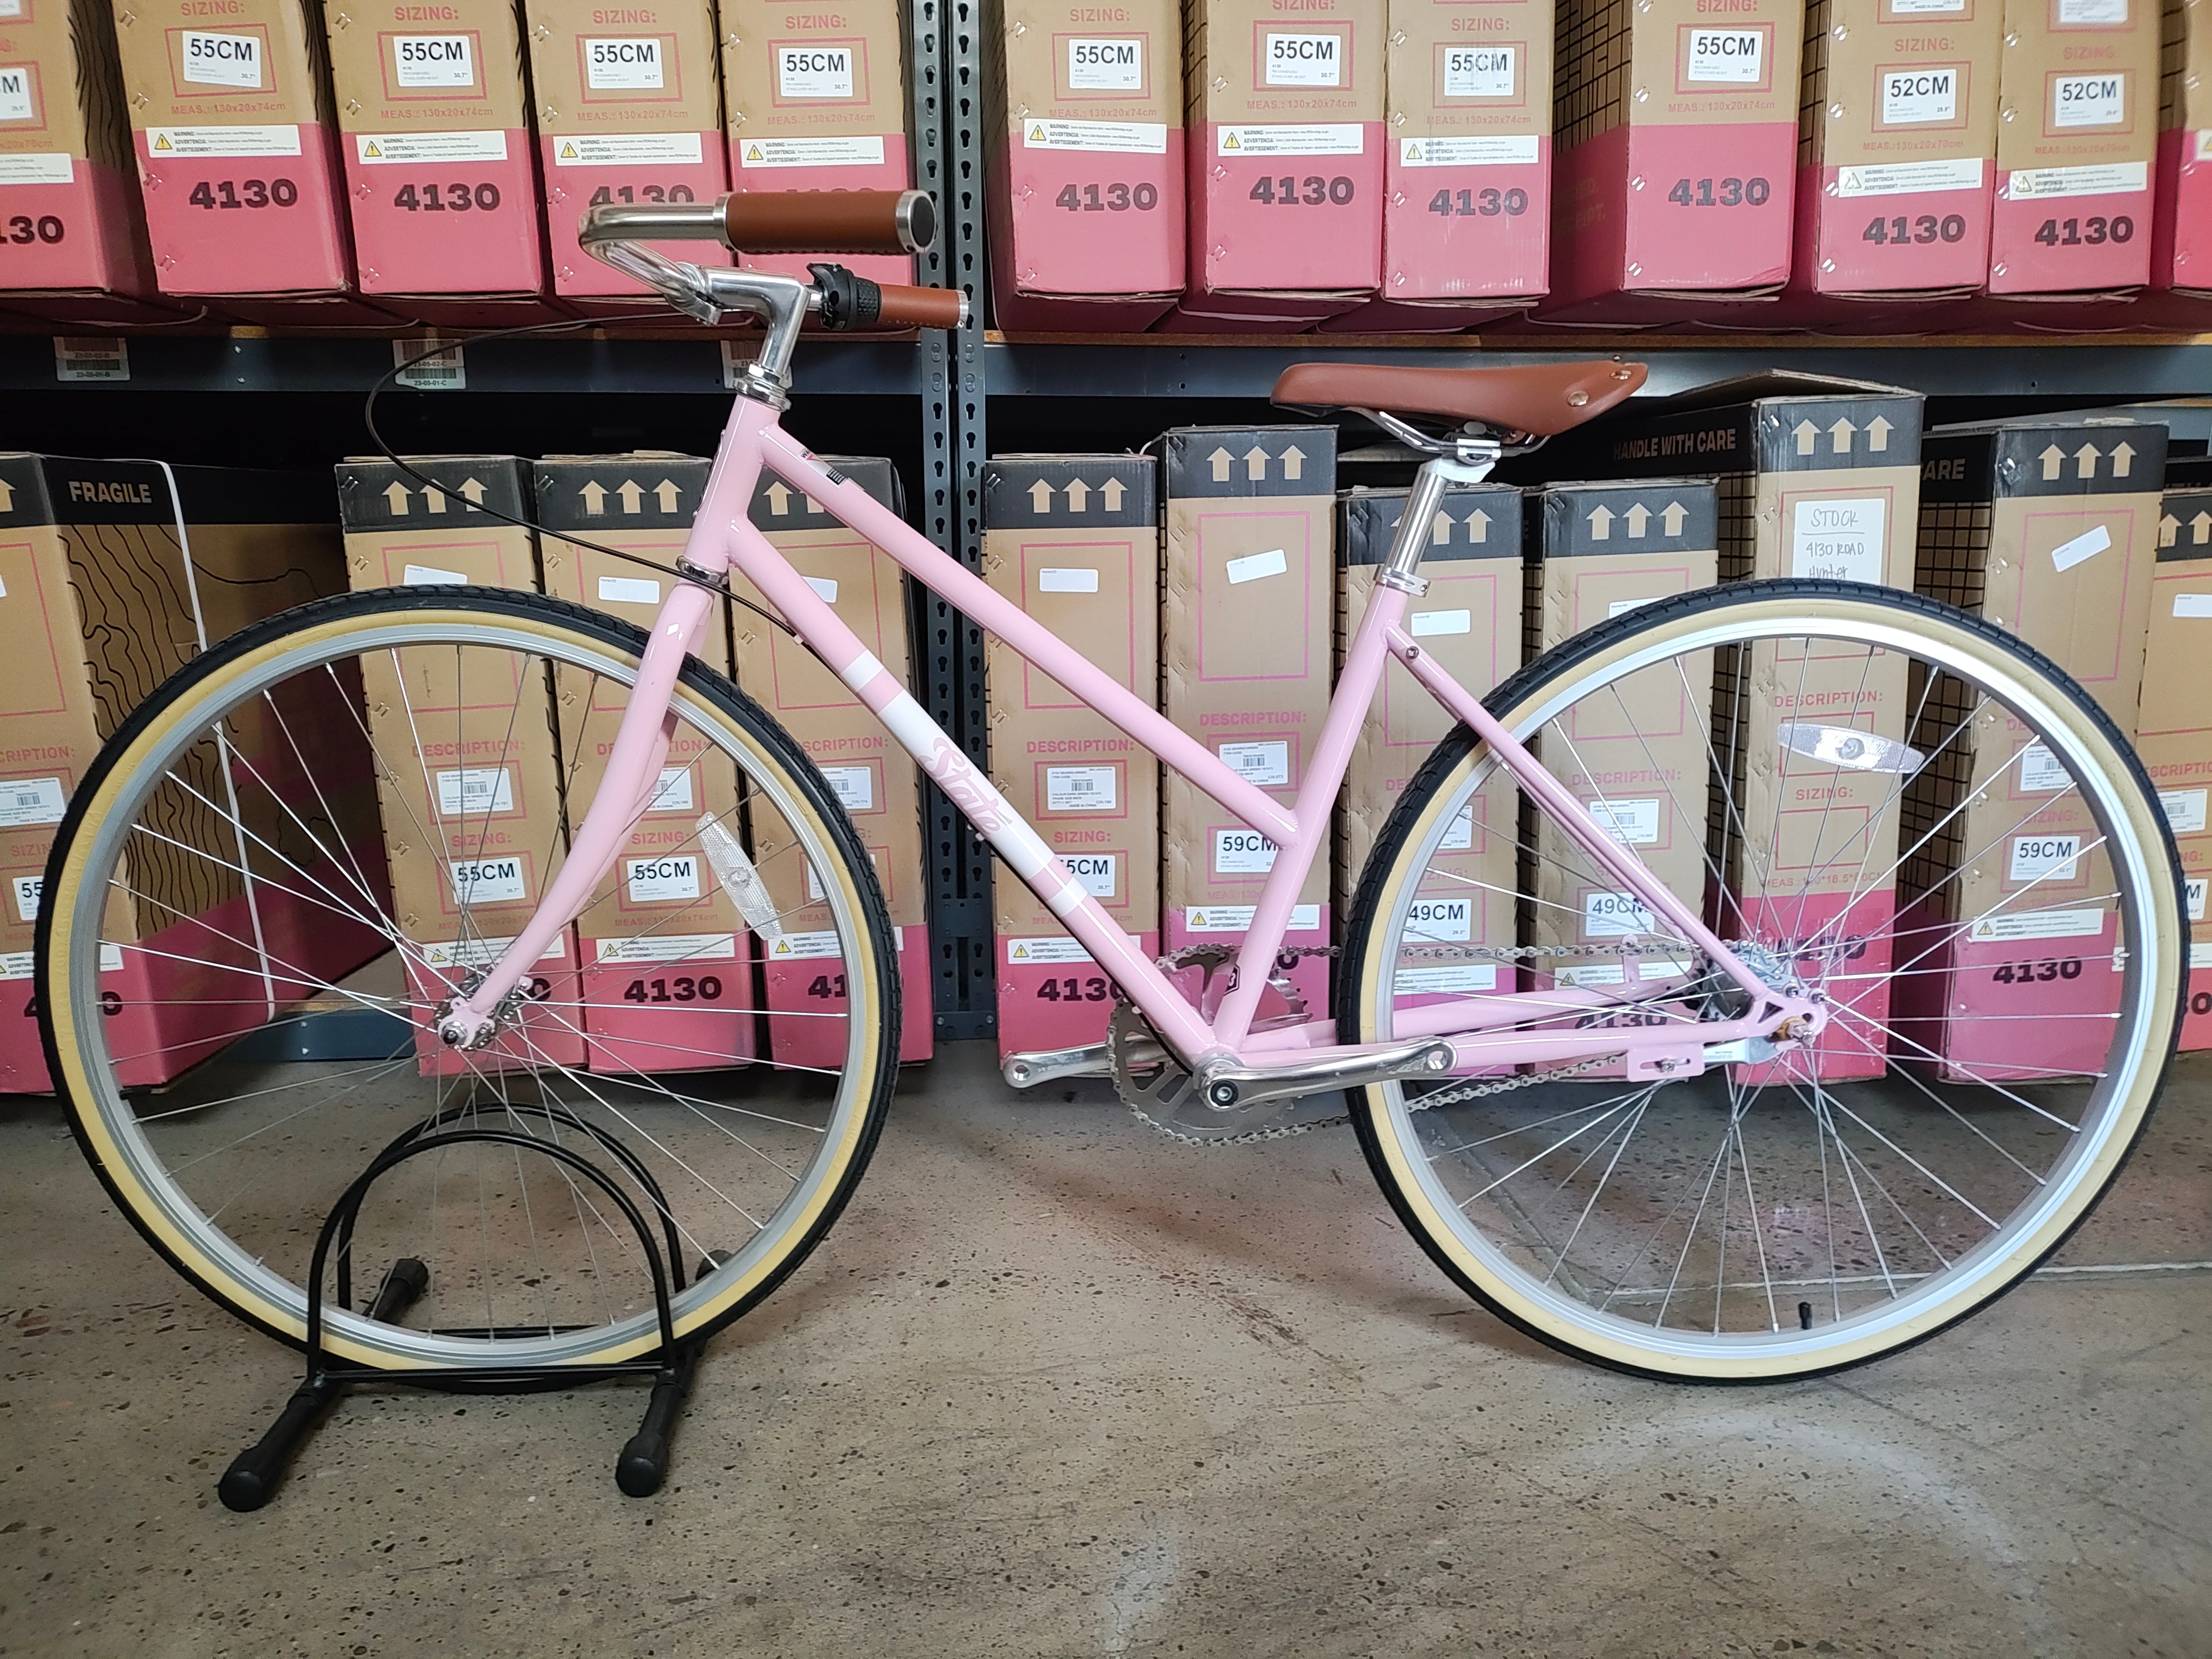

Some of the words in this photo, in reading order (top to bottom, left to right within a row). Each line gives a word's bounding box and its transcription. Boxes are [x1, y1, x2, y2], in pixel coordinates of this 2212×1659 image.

[181, 0, 245, 16] SIZING:
[394, 7, 459, 21] SIZING:
[1272, 0, 1335, 10] SIZING:
[1696, 0, 1758, 12] SIZING:
[593, 10, 657, 23] SIZING:
[785, 15, 847, 29] SIZING:
[1070, 9, 1130, 22] SIZING:
[1451, 18, 1510, 31] SIZING:
[190, 38, 253, 61] 55CM
[402, 42, 463, 61] 55CM
[594, 44, 654, 63] 55CM
[1273, 40, 1333, 60] 55CM
[1697, 37, 1755, 55] 55CM
[1894, 38, 1955, 52] SIZING:
[786, 54, 844, 72] 55CM
[1076, 45, 1133, 64] 55CM
[1451, 53, 1507, 72] 55CM
[1891, 76, 1949, 97] 52CM
[2062, 80, 2117, 101] 52CM
[423, 107, 493, 117] 130x20x74cm
[1090, 108, 1157, 117] 130x20x74cm
[1288, 99, 1357, 109] 130x20x74cm
[1708, 100, 1775, 111] 130x20x74cm
[619, 110, 688, 120] 130x20x74cm
[807, 113, 875, 123] 130x20x74cm
[1466, 115, 1531, 124] 130x20x74cm
[189, 178, 299, 210] 4130
[394, 182, 501, 211] 4130
[1055, 182, 1159, 211] 4130
[1249, 176, 1354, 206] 4130
[1669, 178, 1770, 207] 4130
[1428, 188, 1529, 216] 4130
[0, 215, 64, 244] 30
[1863, 214, 1966, 245] 4130
[2034, 216, 2134, 247] 4130
[1614, 437, 1658, 461] HANDLE
[1661, 433, 1694, 455] WITH
[1697, 428, 1736, 452] CARE
[1921, 458, 1966, 481] ARE
[68, 481, 152, 504] FRAGILE
[1811, 508, 1859, 527] STOCK
[1805, 542, 1833, 558] 4130
[1836, 543, 1865, 557] ROAD
[1774, 690, 1883, 708] DESCRIPTION:
[1199, 711, 1306, 726] DESCRIPTION:
[411, 740, 526, 758] DESCRIPTION:
[802, 737, 888, 752] SCRIPTION:
[1027, 739, 1134, 753] DESCRIPTION:
[0, 745, 75, 763] RIPTION:
[1571, 768, 1681, 786] DESCRIPTION:
[918, 737, 1013, 836] State
[1795, 786, 1853, 801] SIZING:
[451, 832, 511, 847] SIZING:
[631, 830, 690, 845] SIZING:
[1054, 830, 1111, 843] SIZING:
[1222, 836, 1277, 851] 59CM
[11, 843, 51, 857] SIZIN
[2019, 841, 2072, 858] 59CM
[458, 863, 515, 882] 55CM
[634, 862, 691, 880] 55CM
[1059, 859, 1109, 875] 5CM
[1409, 904, 1464, 921] 49CM
[1992, 956, 2082, 984] 4130
[624, 975, 723, 1003] 4130
[807, 974, 846, 999] 41
